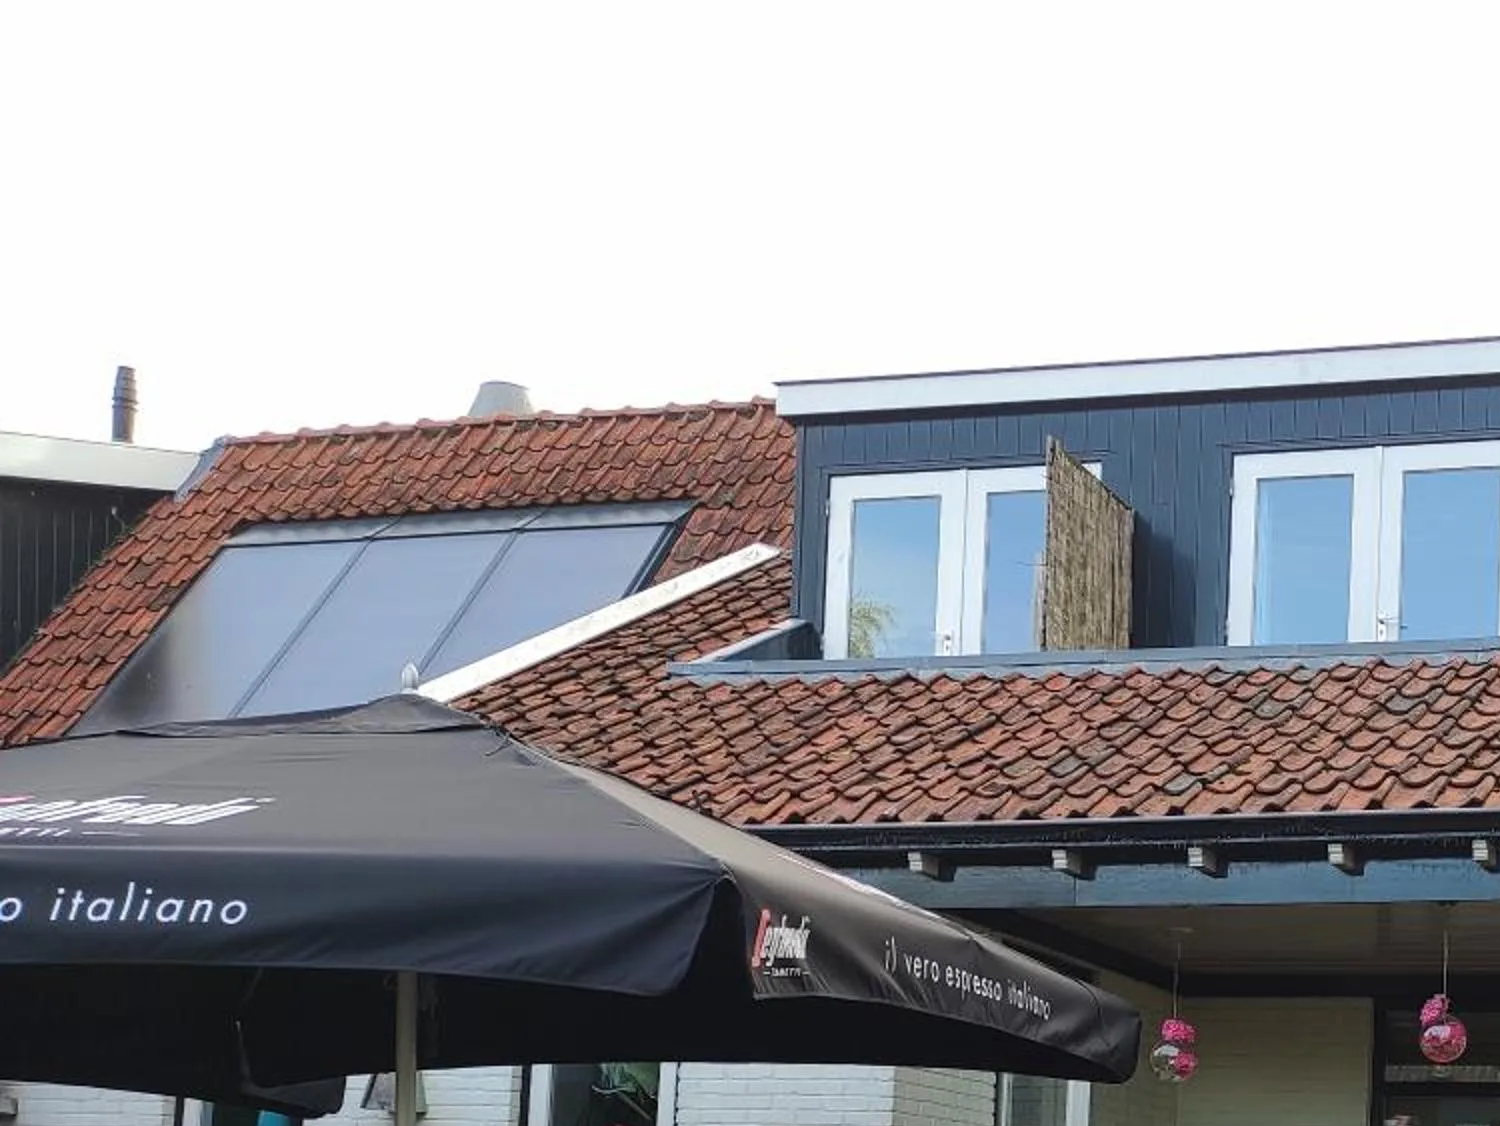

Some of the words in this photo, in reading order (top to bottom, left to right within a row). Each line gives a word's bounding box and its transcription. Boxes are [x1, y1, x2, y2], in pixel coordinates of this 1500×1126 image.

[50, 880, 248, 925] italiano
[884, 935, 897, 972] il
[903, 952, 941, 983] vero
[945, 965, 1003, 1001] espresso
[1006, 978, 1052, 1021] italiano
